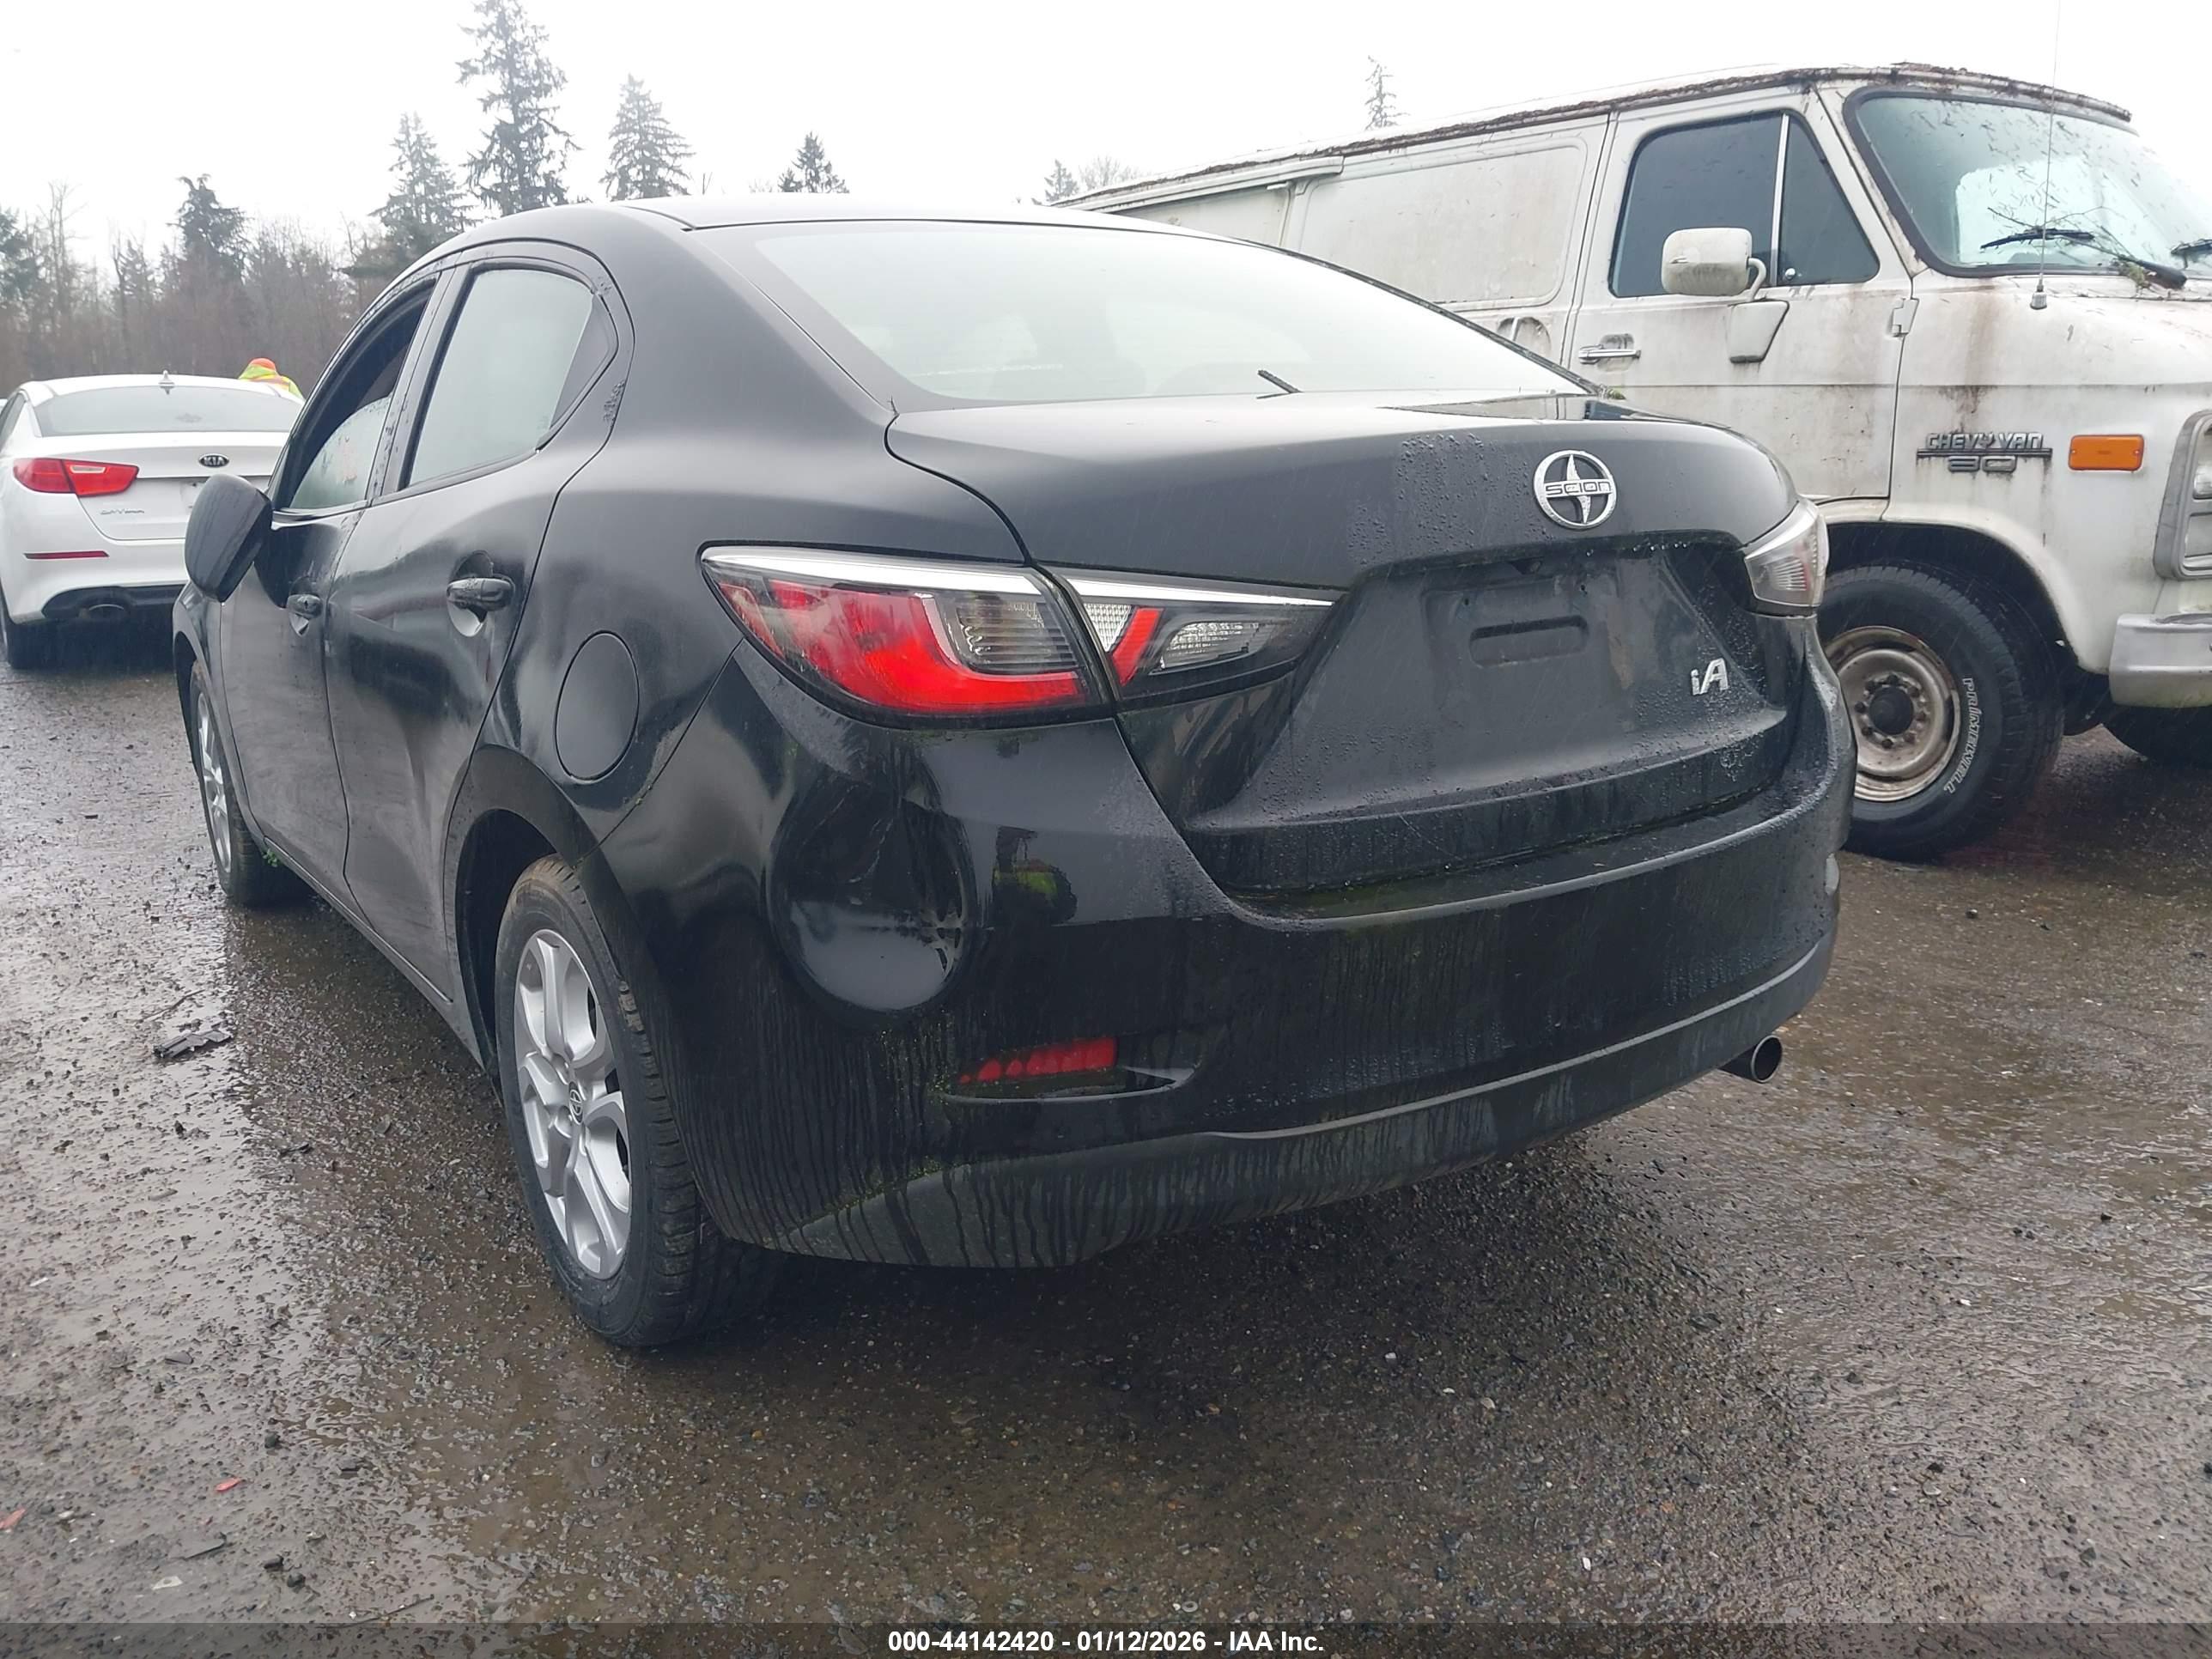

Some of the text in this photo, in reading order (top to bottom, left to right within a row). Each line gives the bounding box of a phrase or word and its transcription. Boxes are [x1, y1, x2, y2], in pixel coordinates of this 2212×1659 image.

[1926, 432, 2044, 449] CHEVY VAN
[204, 456, 225, 466] KIA
[1546, 481, 1612, 495] SCION
[1691, 658, 1729, 695] iA
